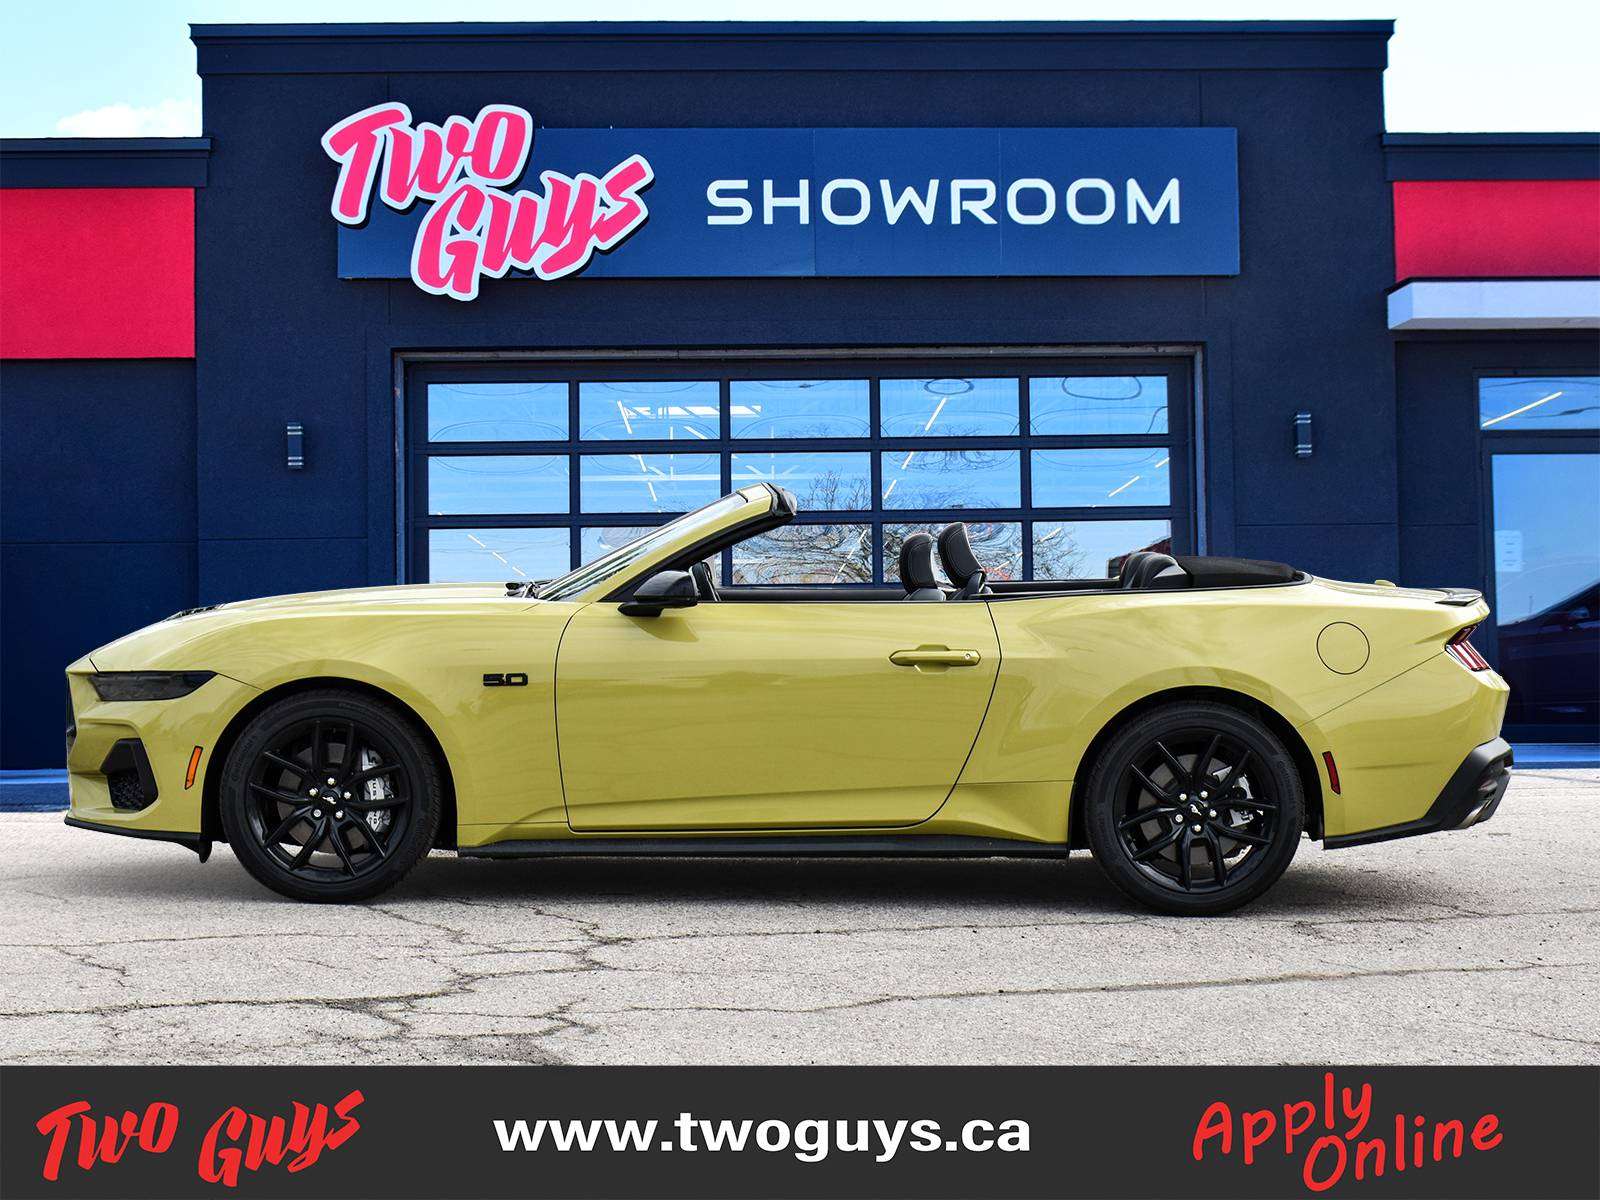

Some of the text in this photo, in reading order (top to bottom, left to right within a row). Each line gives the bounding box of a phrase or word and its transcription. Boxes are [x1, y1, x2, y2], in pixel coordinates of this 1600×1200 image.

[327, 107, 528, 219] Two
[706, 178, 1180, 225] SHOWROOM
[415, 158, 649, 297] Guys
